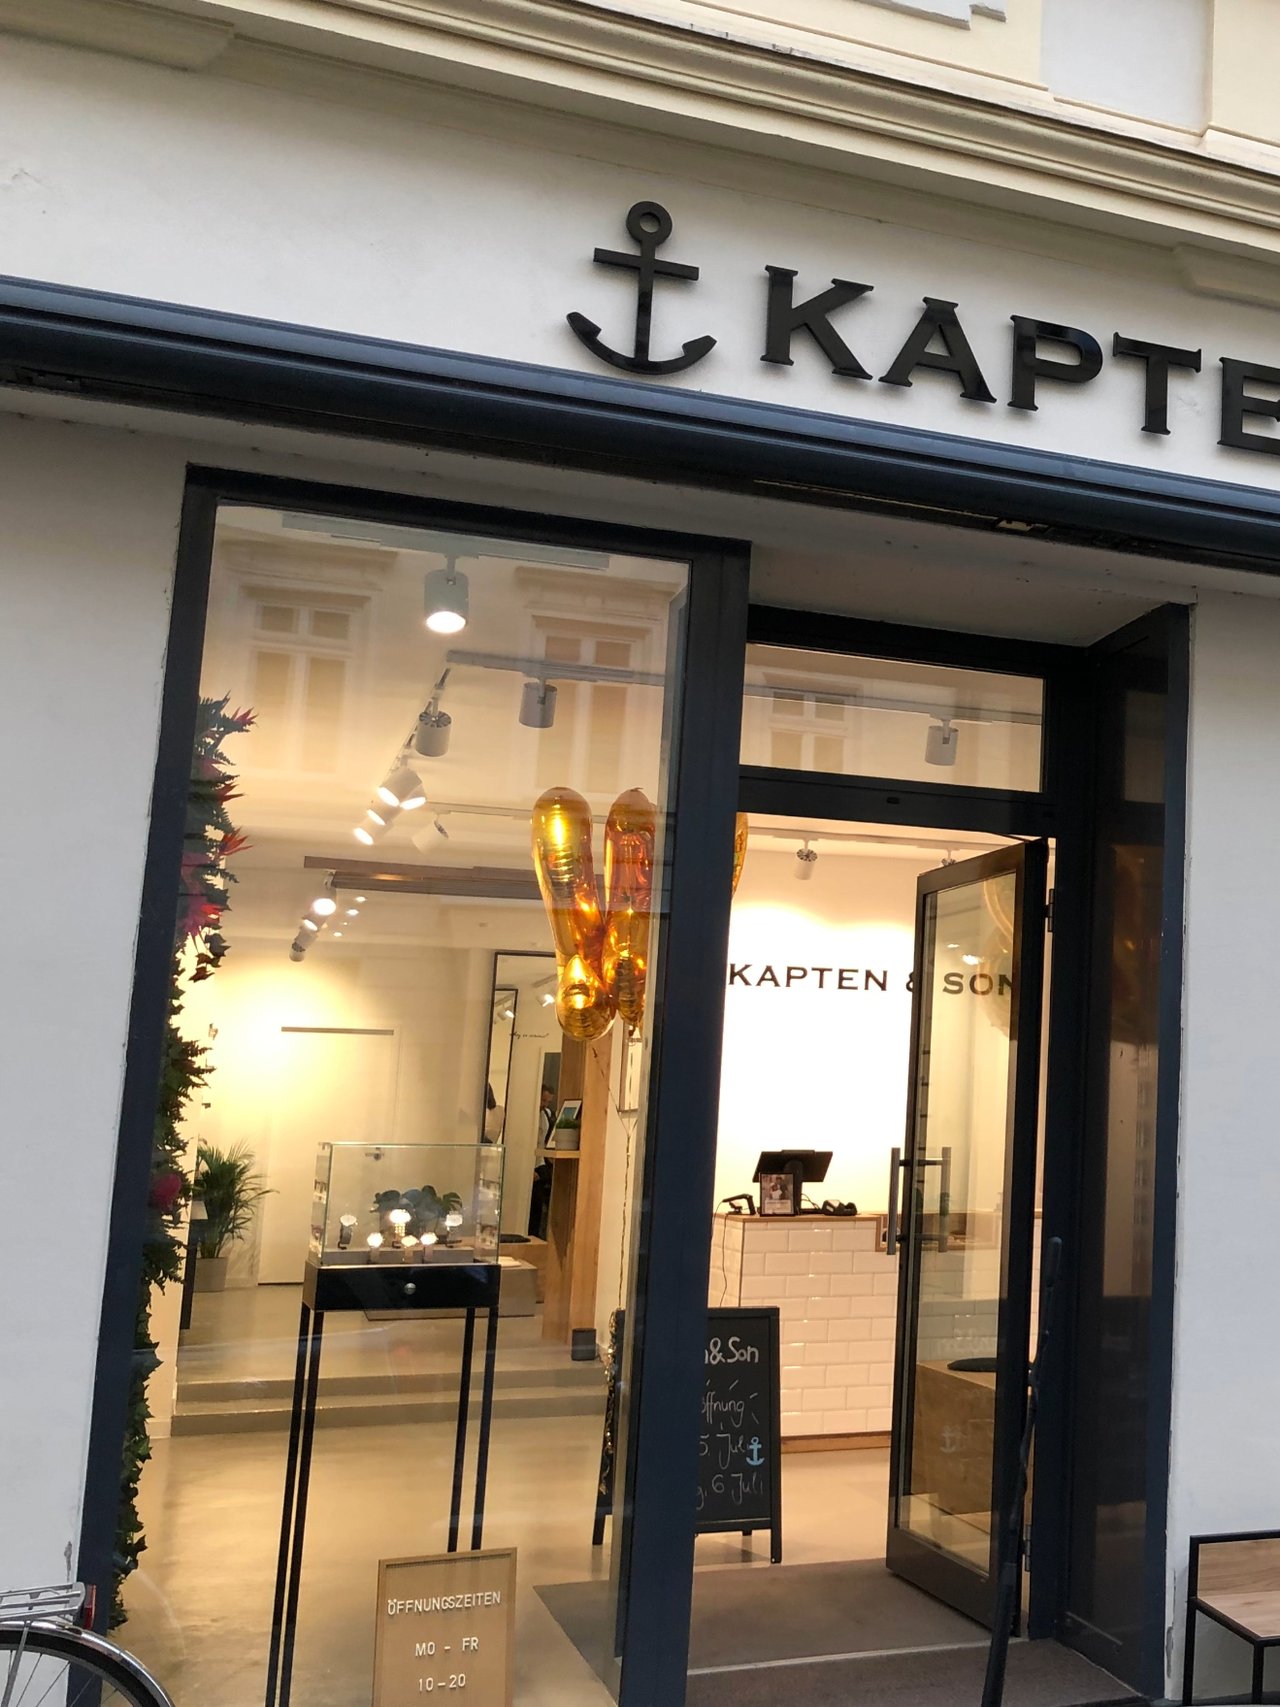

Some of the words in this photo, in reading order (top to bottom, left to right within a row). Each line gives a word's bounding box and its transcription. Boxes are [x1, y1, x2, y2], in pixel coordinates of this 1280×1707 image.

[728, 963, 888, 991] KAPTEN
[387, 1591, 501, 1616] ÖFFNUNGSZEITEN
[415, 1641, 436, 1657] MO
[462, 1636, 479, 1651] FR
